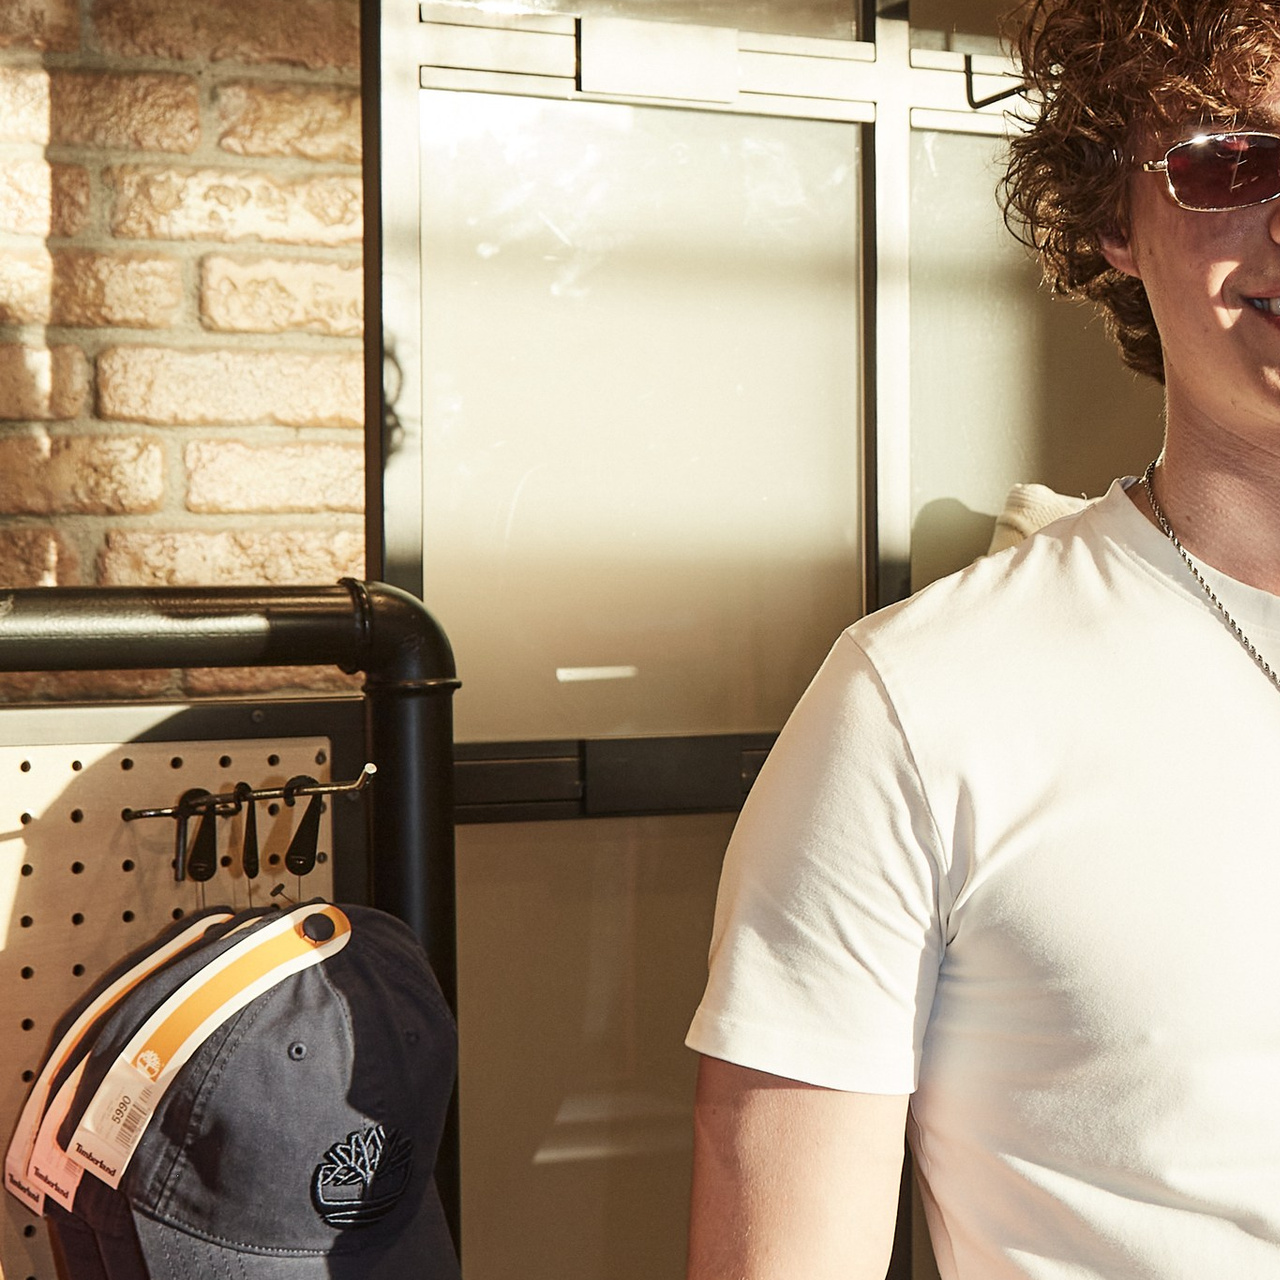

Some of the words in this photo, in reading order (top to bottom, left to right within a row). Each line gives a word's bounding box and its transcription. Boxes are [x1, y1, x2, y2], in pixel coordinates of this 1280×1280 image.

[112, 1095, 132, 1124] 5990
[76, 1143, 117, 1177] Timberland
[8, 1173, 40, 1203] Timberland
[33, 1166, 70, 1199] Timberland
